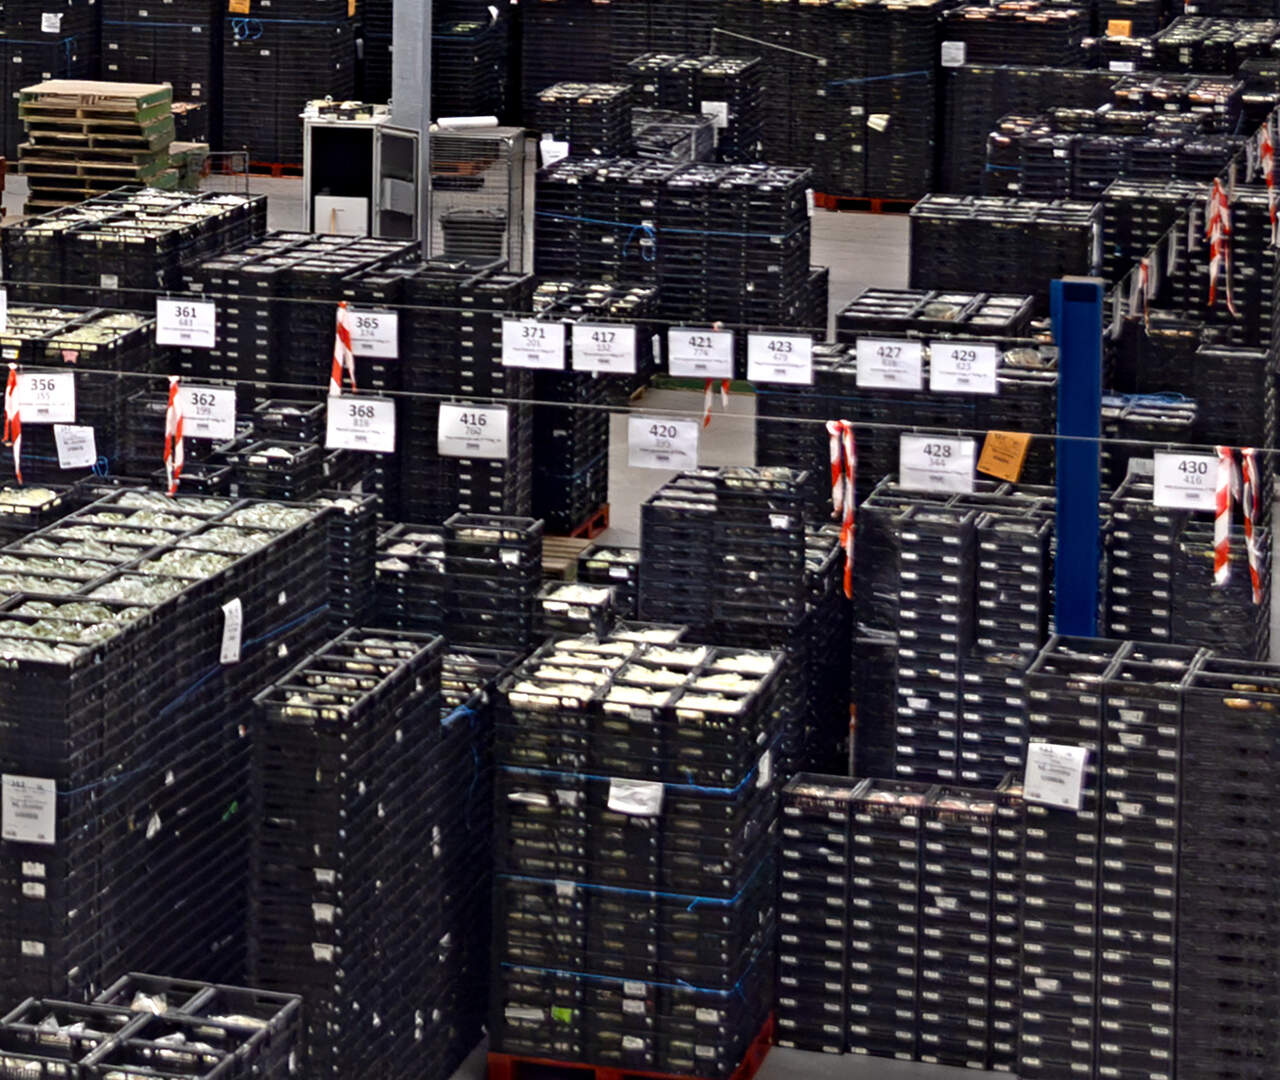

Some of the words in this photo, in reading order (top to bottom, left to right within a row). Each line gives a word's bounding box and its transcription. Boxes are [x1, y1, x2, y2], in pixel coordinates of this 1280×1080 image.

[177, 306, 196, 318] 361
[357, 317, 379, 329] 365
[523, 327, 545, 339] 371
[592, 332, 615, 343] 417
[689, 337, 712, 348] 421
[768, 341, 792, 353] 423
[877, 346, 901, 358] 427
[952, 350, 976, 361] 429
[32, 379, 55, 391] 356
[192, 393, 215, 406] 362
[350, 405, 374, 418] 368
[460, 413, 486, 426] 416
[650, 425, 677, 438] 420
[924, 444, 952, 458] 428
[1179, 461, 1207, 475] 430
